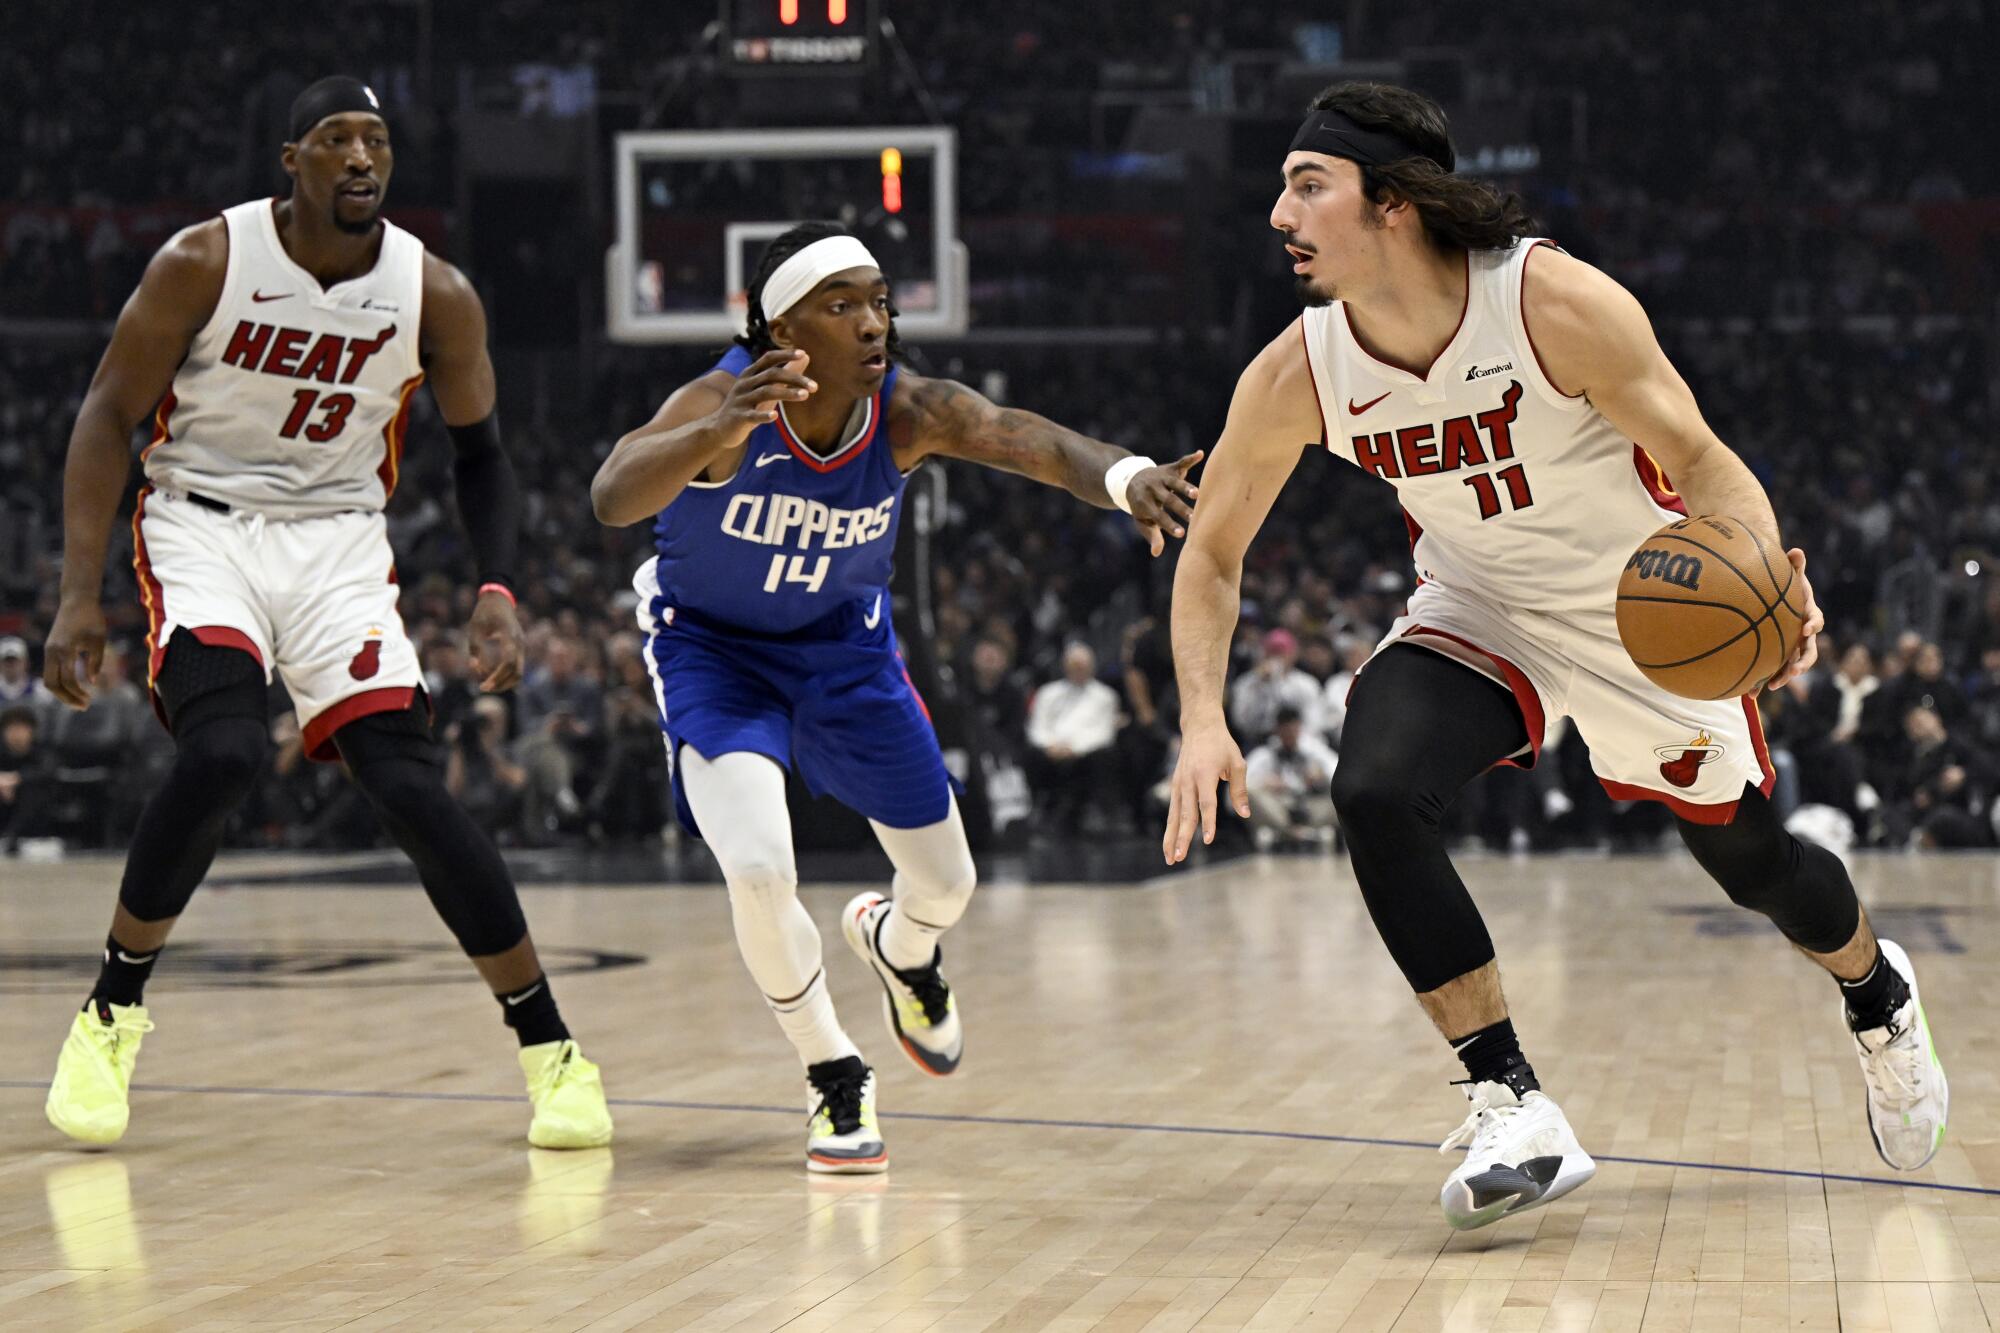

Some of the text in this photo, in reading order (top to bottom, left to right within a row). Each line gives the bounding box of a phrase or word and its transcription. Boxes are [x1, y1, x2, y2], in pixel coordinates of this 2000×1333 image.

[221, 319, 397, 385] HEAT
[1475, 361, 1513, 378] Carnival
[279, 388, 356, 442] 13
[1352, 379, 1524, 479] HEAT
[1462, 463, 1534, 521] 11
[720, 493, 895, 550] CLIPPERS
[763, 553, 831, 593] 14
